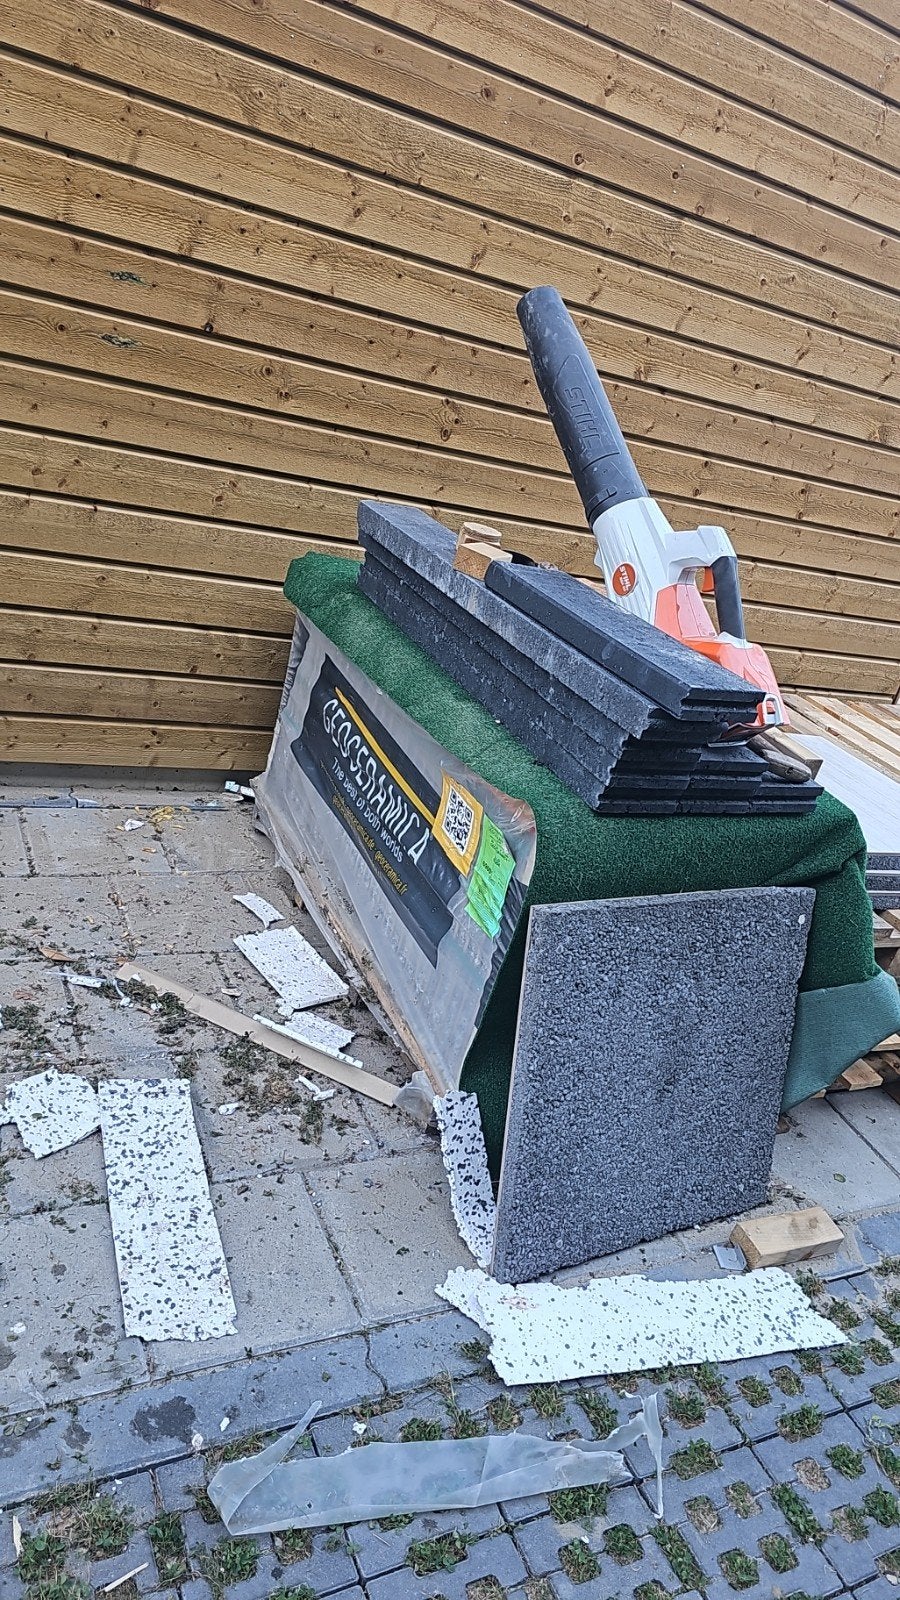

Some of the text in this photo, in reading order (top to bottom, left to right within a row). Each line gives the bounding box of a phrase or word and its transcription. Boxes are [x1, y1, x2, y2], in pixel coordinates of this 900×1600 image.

[564, 386, 601, 450] STIHL
[619, 566, 631, 591] STIHL
[331, 757, 345, 780] The
[380, 827, 403, 863] worlds
[374, 851, 408, 895] geoceramica.fr
